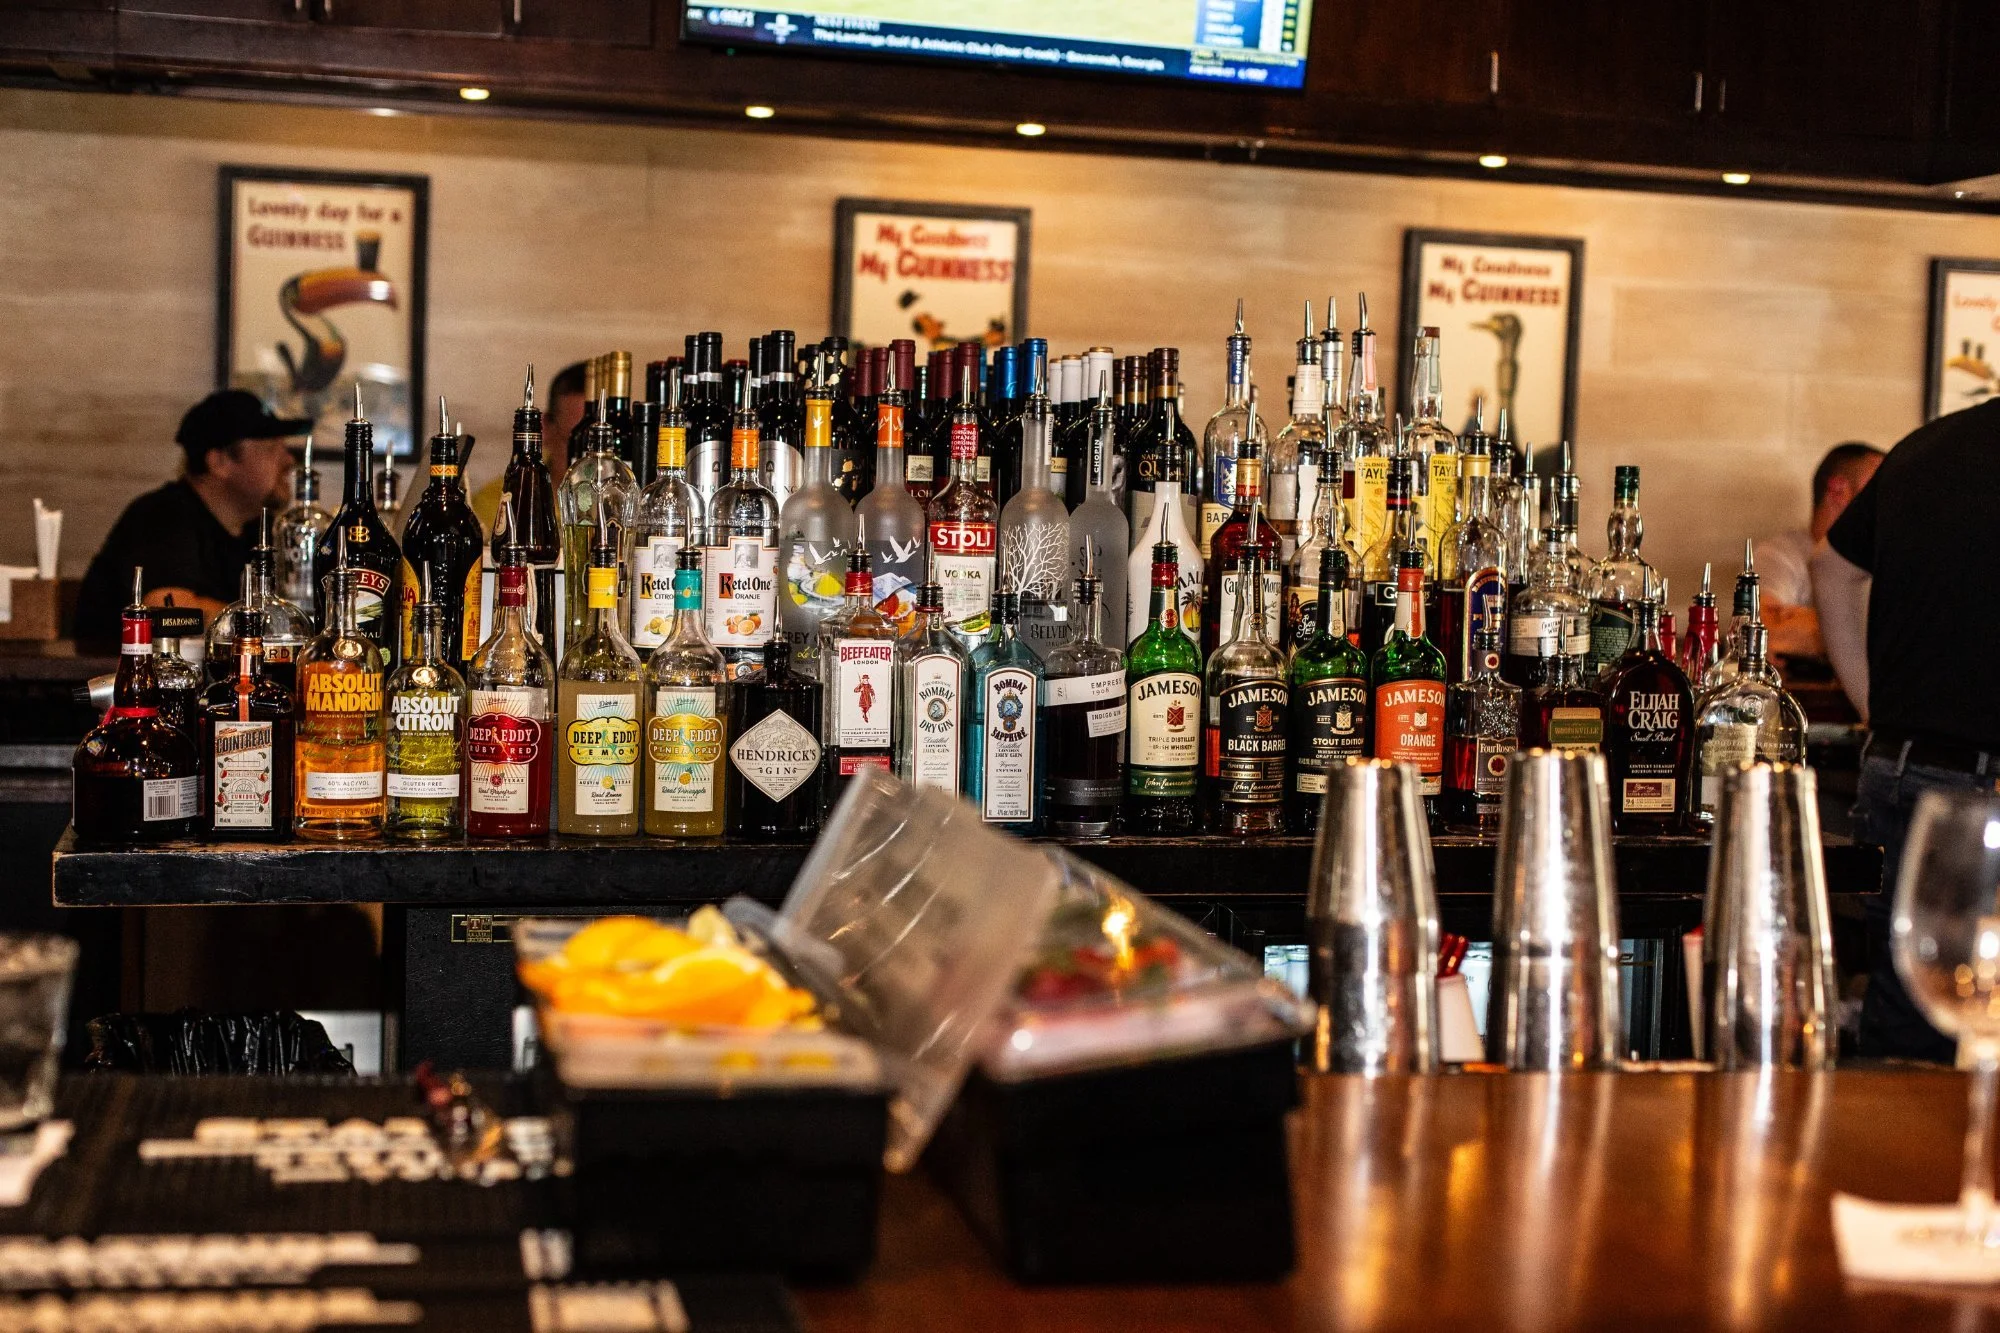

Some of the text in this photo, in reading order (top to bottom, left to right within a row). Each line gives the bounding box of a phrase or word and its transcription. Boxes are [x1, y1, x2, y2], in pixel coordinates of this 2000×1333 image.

[248, 199, 401, 222] Lovely day for a
[247, 224, 345, 249] GUINNESS
[877, 223, 989, 247] My Goodness
[859, 250, 1012, 284] My GUINNESS
[1441, 255, 1552, 278] My Goodness
[1428, 278, 1560, 305] My GUINNESS
[1093, 439, 1101, 473] CHOPIN
[1359, 467, 1387, 479] TAYL
[910, 489, 932, 499] LOH
[1206, 512, 1228, 523] BAR
[936, 528, 991, 547] STOLI
[353, 572, 387, 590] LEYS
[945, 569, 981, 579] VODKA
[642, 575, 670, 597] Ketel
[721, 575, 771, 597] Ketel One
[1263, 578, 1281, 595] Morg
[654, 592, 674, 600] CITRO
[840, 646, 892, 662] BEEFEATER
[309, 673, 383, 693] ABSOLUT
[993, 679, 1028, 695] BOMBAY
[1091, 678, 1122, 689] EMPRESS
[1137, 679, 1200, 701] JAMESON
[306, 691, 383, 712] MANDRIN
[919, 687, 955, 702] BOMBAY
[1228, 687, 1288, 708] JAMESON
[1307, 687, 1367, 707] JAMESON
[1385, 690, 1446, 708] JAMESON
[1629, 691, 1680, 712] ELIJAH
[391, 696, 459, 713] ABSOLUT
[396, 713, 454, 731] CITRON
[1092, 712, 1112, 720] INDIGO
[1628, 710, 1679, 731] CRAIG
[919, 719, 954, 733] DRY GIN
[216, 728, 271, 754] COINTREAU
[469, 727, 533, 742] DEEP EDDY
[573, 730, 637, 744] DEEP EDDY
[653, 728, 717, 742] DEEP EDDY
[991, 727, 1027, 742] SAPPHIRE
[1312, 738, 1364, 746] STOUT EDITIO
[1401, 734, 1436, 747] ORANGE
[1630, 731, 1676, 742] Small Batch
[470, 745, 496, 754] RUBY
[577, 748, 635, 756] LEMON
[1228, 739, 1259, 751] BLACK
[1480, 743, 1515, 753] Four Roses
[737, 749, 817, 761] HENDRICK'S
